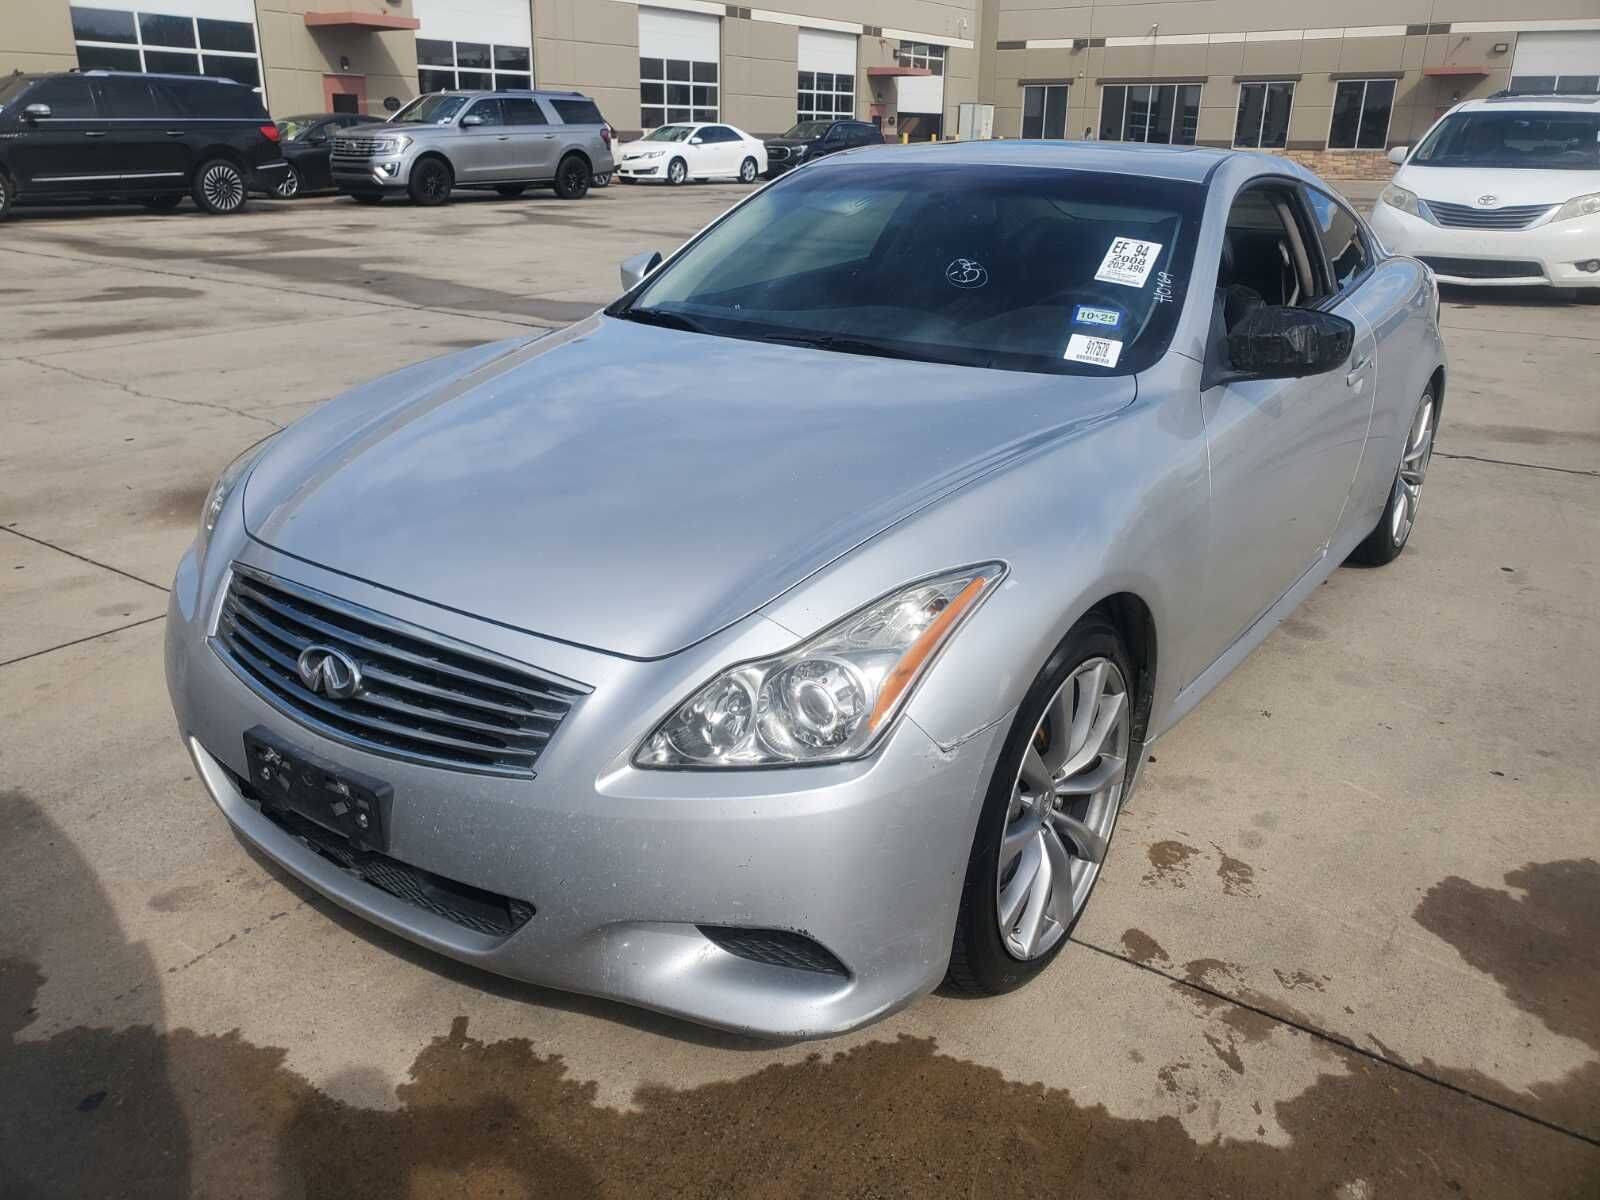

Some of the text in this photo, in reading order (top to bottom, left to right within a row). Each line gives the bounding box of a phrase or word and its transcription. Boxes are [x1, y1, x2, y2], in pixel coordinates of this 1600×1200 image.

[1112, 241, 1150, 258] EF 94
[1112, 254, 1146, 266] 2008
[1080, 311, 1116, 323] 10 25
